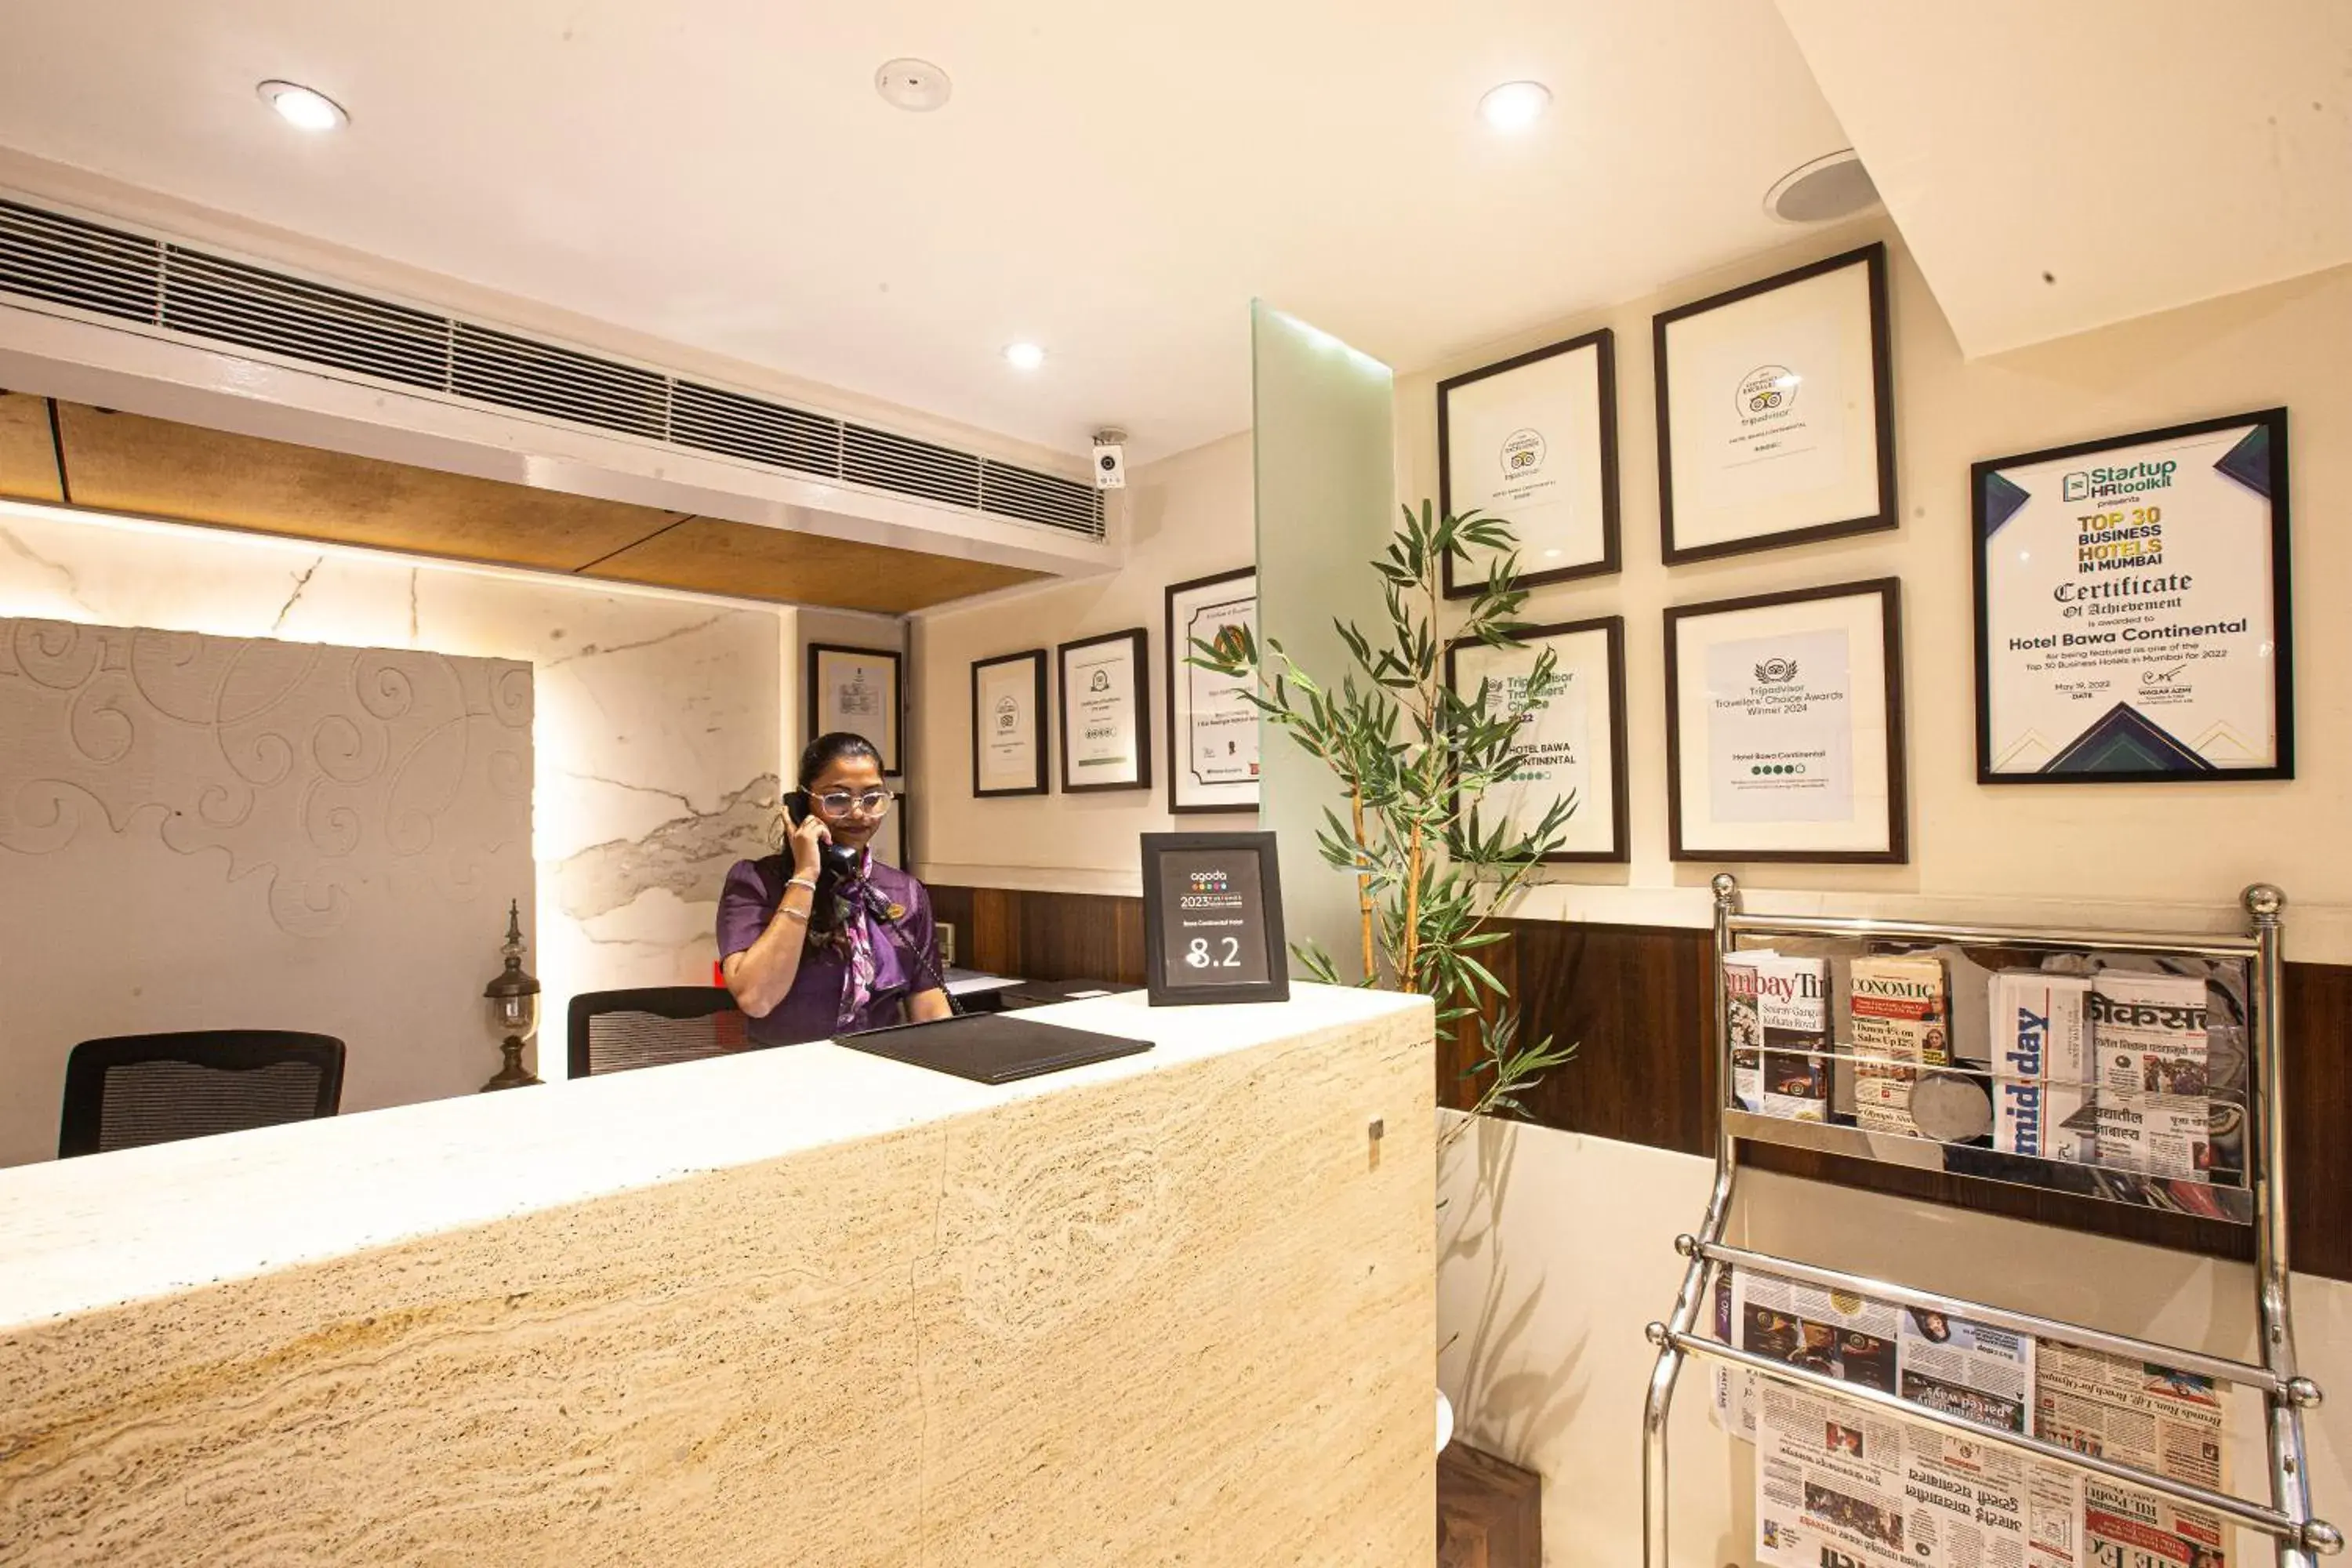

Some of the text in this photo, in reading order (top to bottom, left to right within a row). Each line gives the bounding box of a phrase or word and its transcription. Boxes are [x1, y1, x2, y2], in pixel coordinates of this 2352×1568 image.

[2092, 460, 2176, 484] Startup
[2092, 475, 2171, 498] HRtoolkit
[2078, 506, 2161, 532] TOP 30
[2078, 524, 2161, 546] BUSINESS
[2078, 539, 2162, 561] HOTELS
[2078, 554, 2162, 573] IN MUMBAI
[2054, 574, 2193, 602] Certificate
[2089, 597, 2182, 615] Achievement
[2009, 618, 2247, 650] Hotel Bawa Continental
[1507, 673, 1573, 688] Tripisor
[1541, 742, 1570, 753] BAWA
[1518, 755, 1576, 767] NTINENTAL
[1191, 869, 1227, 883] agoda
[1181, 896, 1208, 907] 2023
[1189, 936, 1241, 968] 8.2
[1857, 1034, 1881, 1043] Sales
[1882, 1036, 1896, 1046] Up
